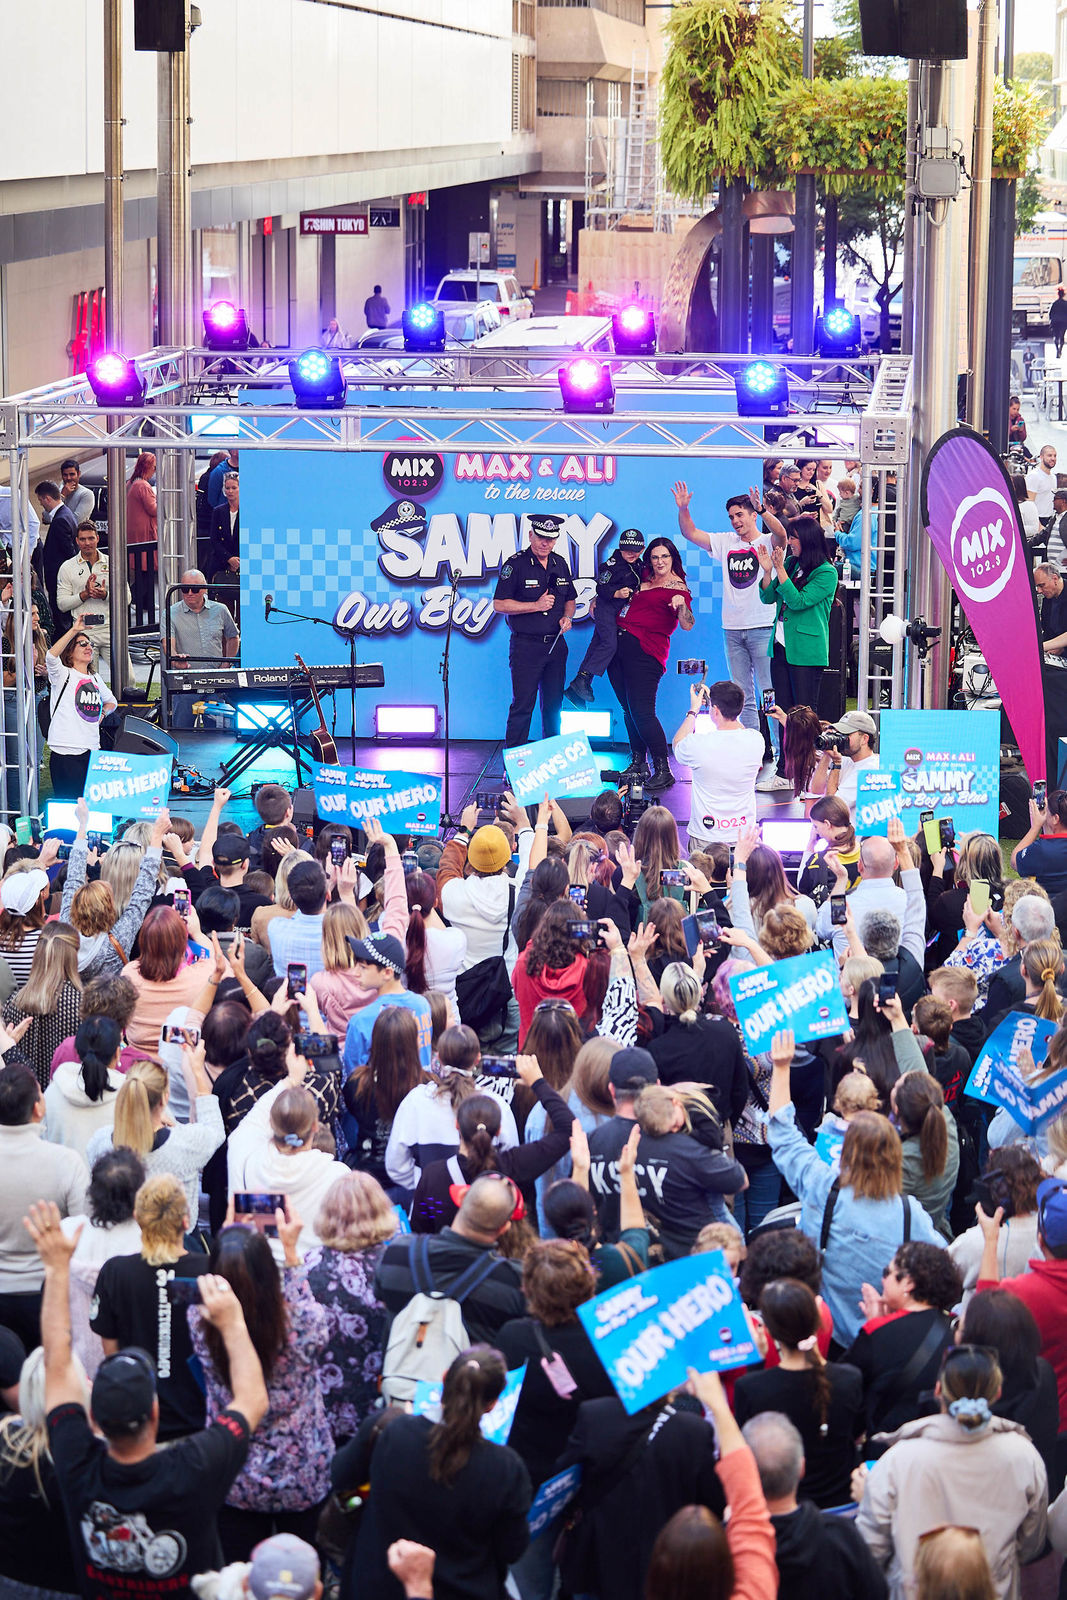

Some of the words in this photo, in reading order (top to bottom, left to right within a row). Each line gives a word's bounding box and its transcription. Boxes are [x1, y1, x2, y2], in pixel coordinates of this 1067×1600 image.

[336, 217, 365, 231] TOKYO
[391, 458, 434, 477] MIX
[455, 453, 532, 480] MAX
[537, 458, 553, 476] &
[560, 454, 614, 480] ALI
[398, 479, 428, 487] 102.3
[485, 484, 501, 500] to
[505, 484, 530, 500] the
[533, 486, 586, 501] rescue
[961, 518, 1006, 567] MIX
[729, 557, 754, 571] MIX
[970, 554, 1001, 578] 102.3
[334, 591, 412, 634] Our
[418, 585, 495, 634] Boy
[254, 674, 288, 683] Roland
[80, 690, 101, 704] MIX
[905, 753, 921, 761] MIX
[926, 752, 949, 762] MAX
[958, 752, 976, 762] ALI
[90, 780, 127, 802] OUR
[127, 767, 169, 795] HERO
[902, 769, 975, 793] SAMMY
[350, 797, 388, 819] OUR
[387, 784, 437, 812] HERO
[914, 793, 940, 808] Boy
[942, 795, 955, 805] in
[957, 790, 988, 804] Blue
[861, 798, 896, 825] OUR
[716, 816, 747, 829] 102.3
[744, 1000, 784, 1041] OUR
[775, 968, 834, 1016] HERO
[616, 1324, 676, 1387] OUR
[658, 1274, 733, 1340] HERO
